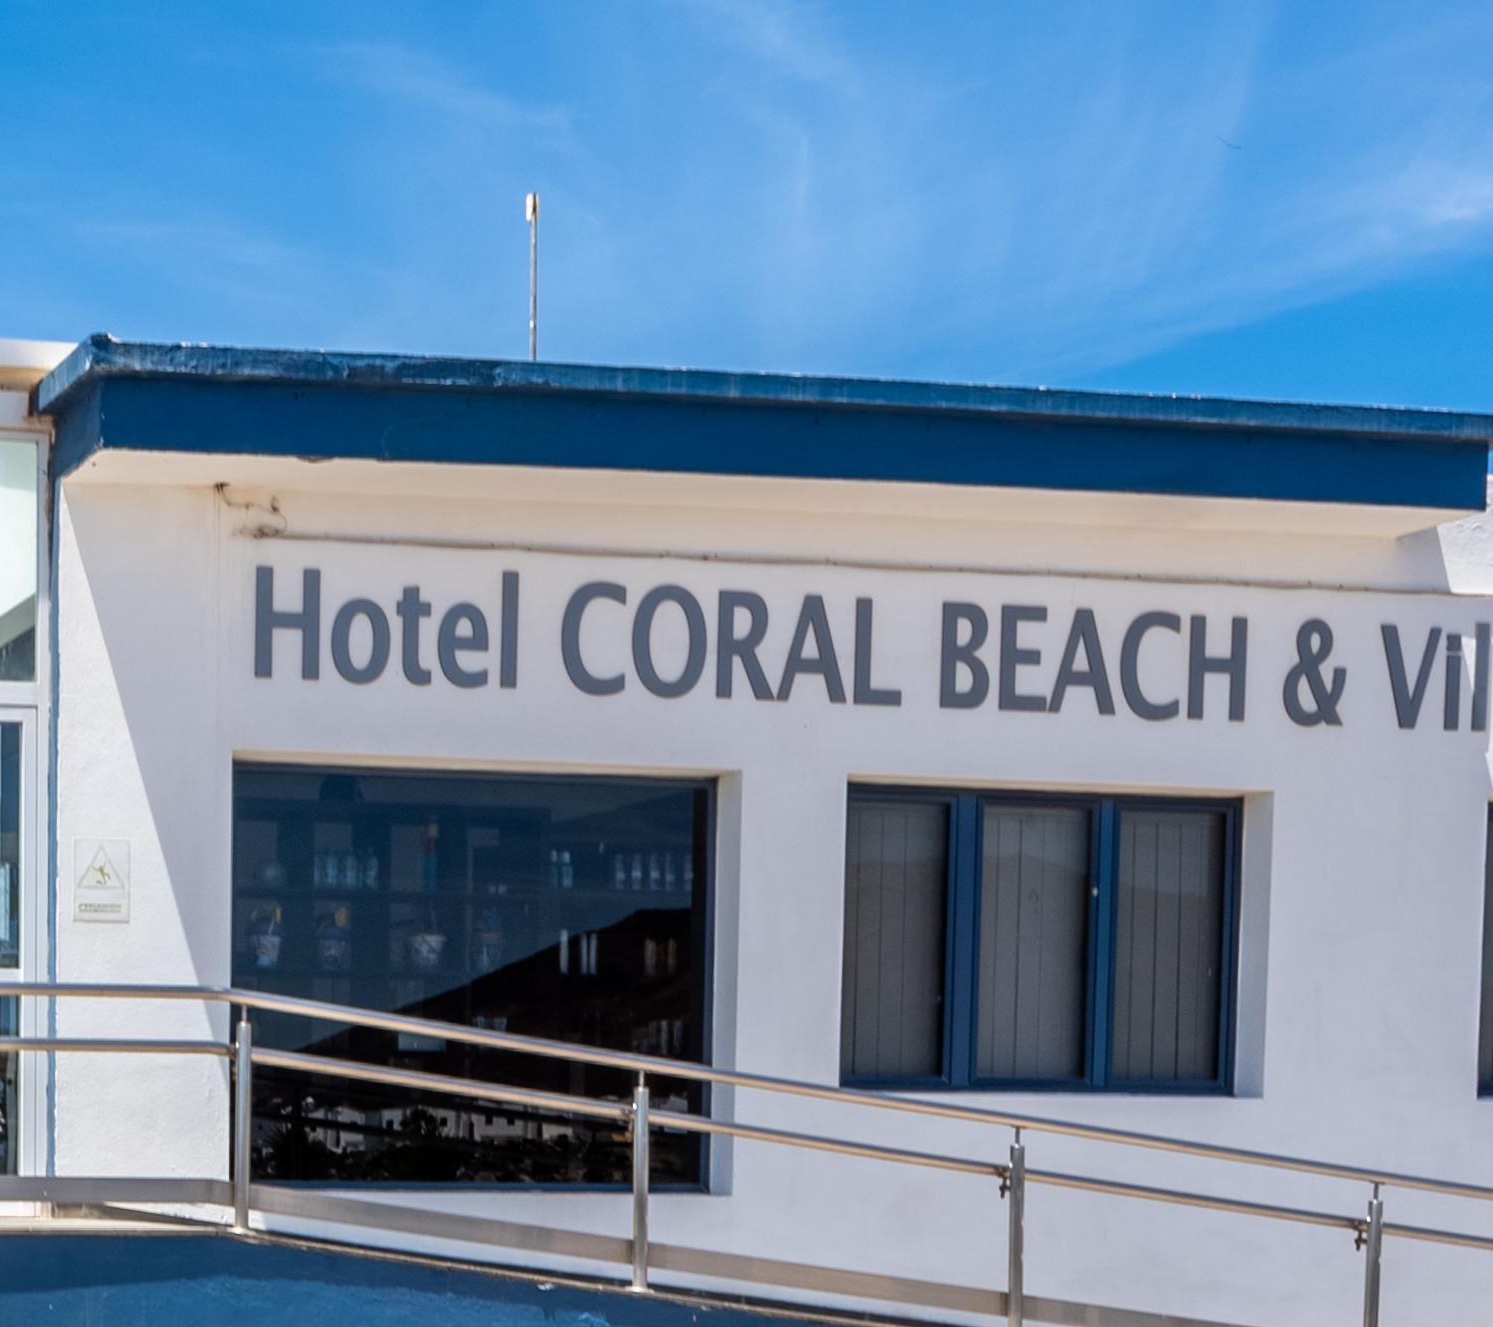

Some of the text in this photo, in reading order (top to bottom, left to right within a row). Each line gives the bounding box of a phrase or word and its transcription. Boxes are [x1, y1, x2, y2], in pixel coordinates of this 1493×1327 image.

[251, 564, 521, 691] Hotel
[559, 580, 903, 708] CORAL
[937, 601, 1250, 723] BEACH
[1281, 616, 1348, 729] &
